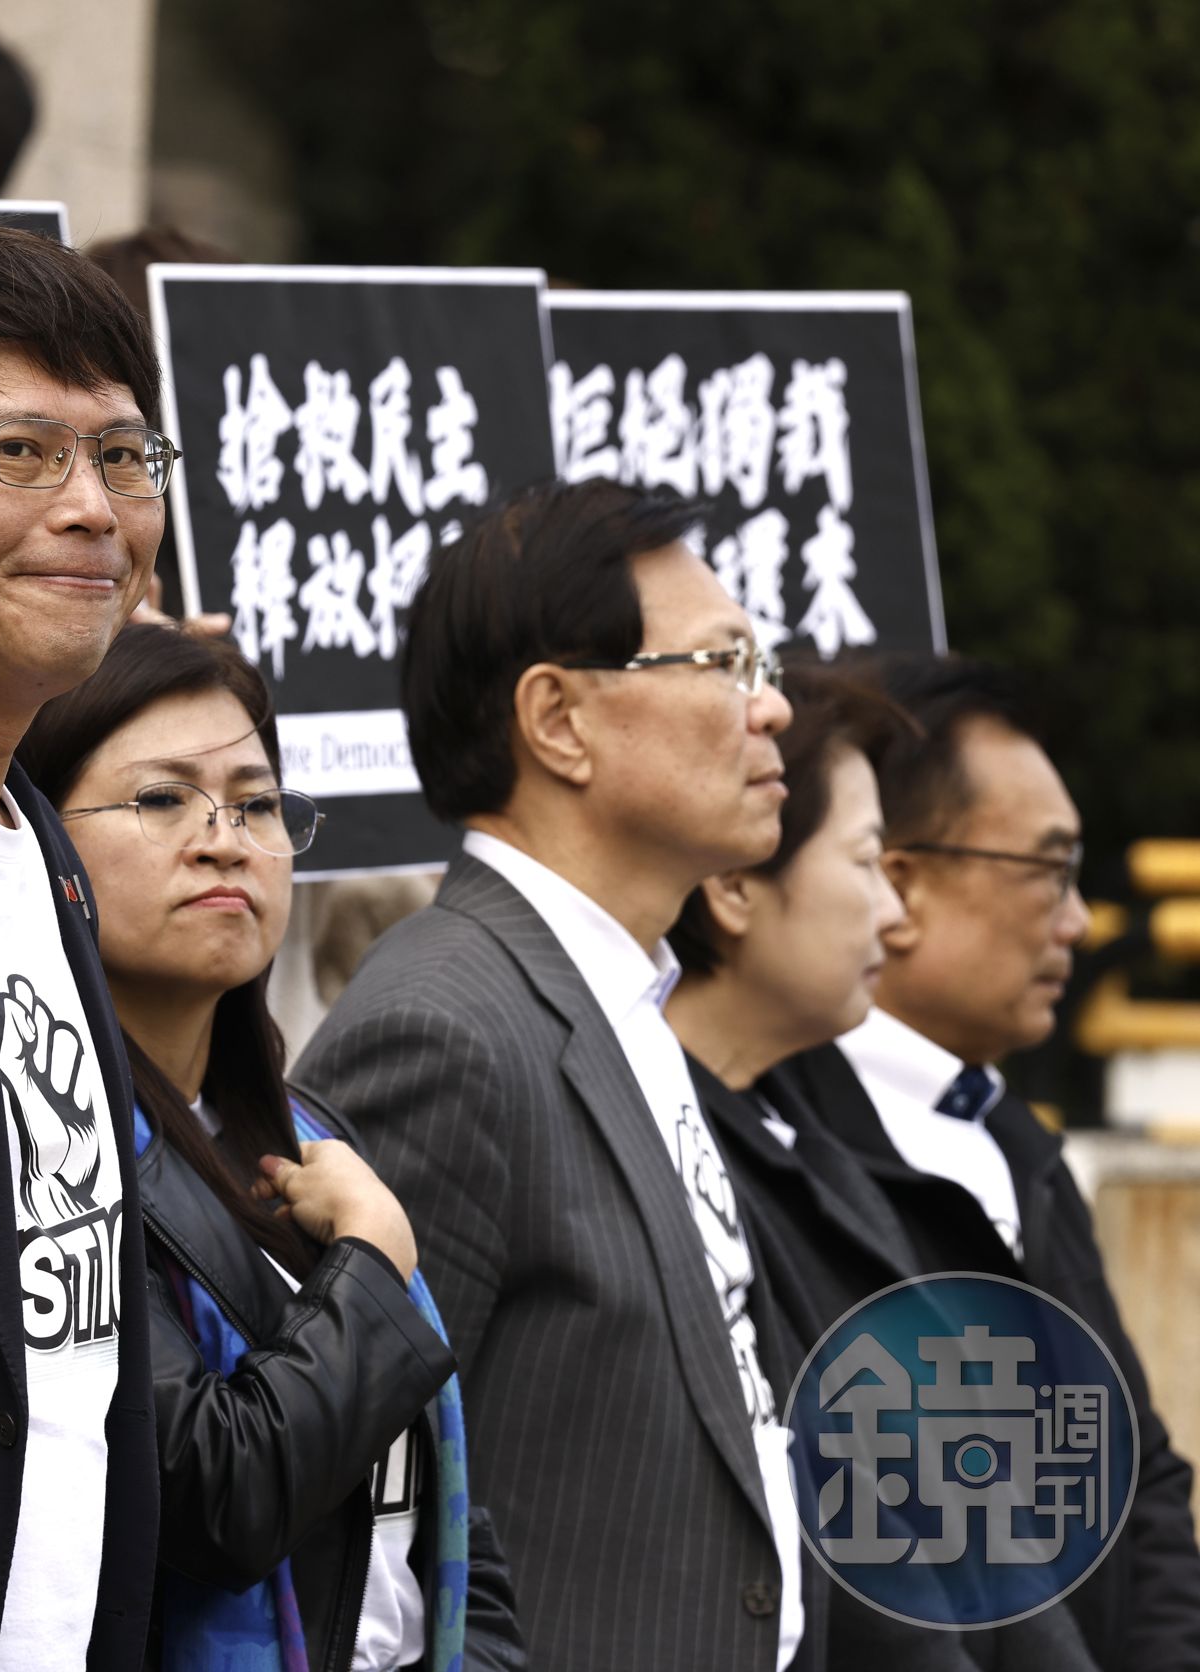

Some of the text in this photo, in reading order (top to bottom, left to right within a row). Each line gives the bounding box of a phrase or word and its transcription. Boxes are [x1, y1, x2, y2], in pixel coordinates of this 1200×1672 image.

[216, 352, 490, 516] 搶救民主
[230, 513, 464, 682] 釋放柯
